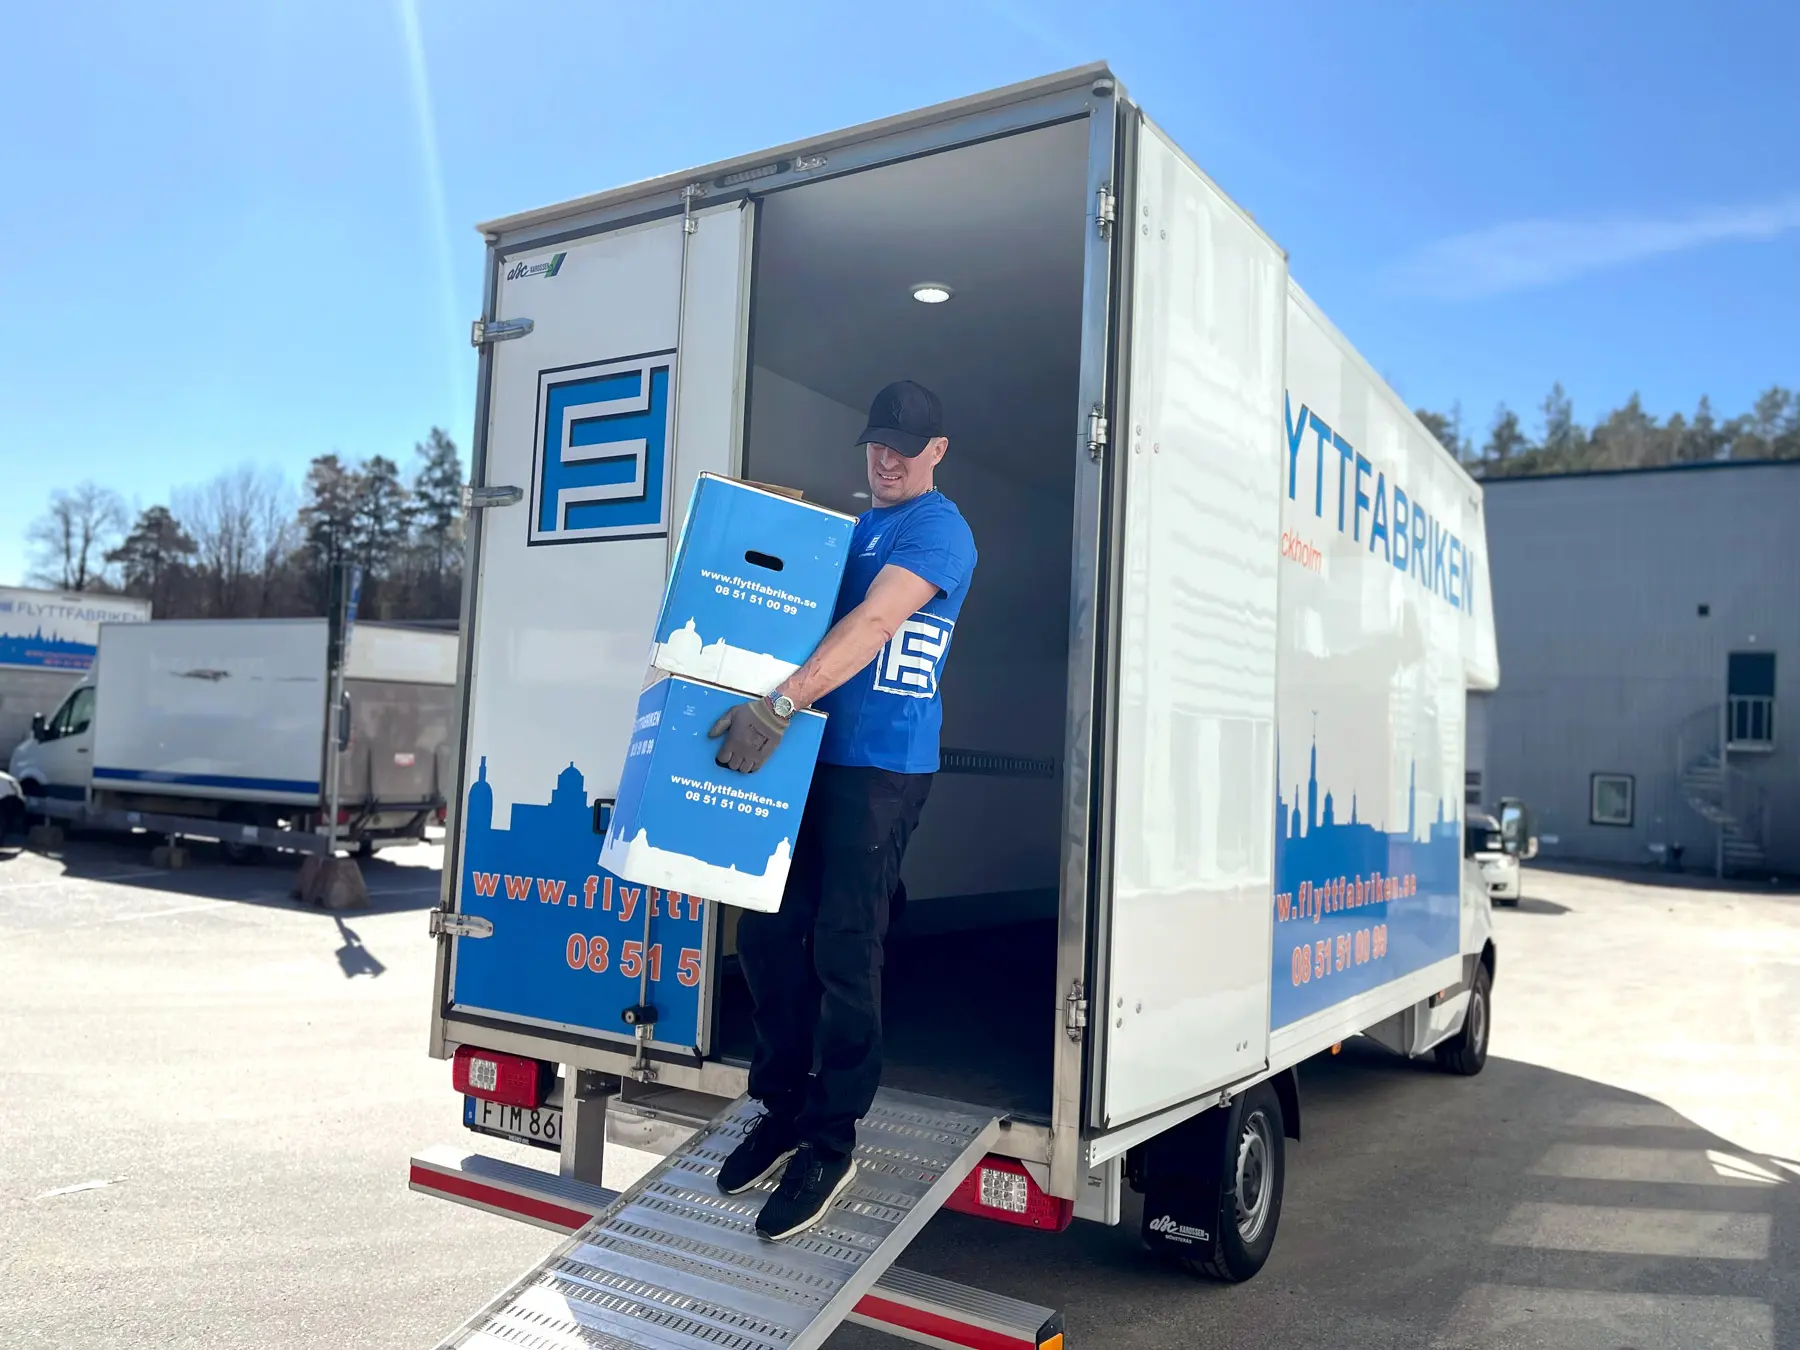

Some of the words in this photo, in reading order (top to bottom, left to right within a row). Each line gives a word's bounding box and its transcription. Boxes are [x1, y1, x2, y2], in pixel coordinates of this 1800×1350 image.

[1285, 388, 1474, 617] YTTFABRIKEN
[1281, 525, 1322, 575] ckholm
[701, 568, 817, 609] www.flyttfabriken.se
[715, 584, 730, 596] 08
[732, 589, 746, 600] 51
[749, 594, 763, 606] 51
[766, 600, 781, 611] 00
[783, 604, 798, 616] 99
[670, 774, 789, 810] www.flyttfabriken.se
[685, 790, 700, 802] 08
[703, 794, 717, 806] 51
[720, 798, 734, 810] 51
[738, 803, 752, 814] 00
[755, 806, 769, 818] 99
[566, 932, 609, 973] 08
[619, 939, 663, 982] 51
[677, 947, 701, 987] 5
[1292, 944, 1311, 987] 08
[1314, 938, 1332, 979] 51
[1336, 932, 1352, 971] 51
[1355, 929, 1370, 965] 00
[483, 1101, 522, 1133] FTM
[529, 1110, 562, 1140] 86
